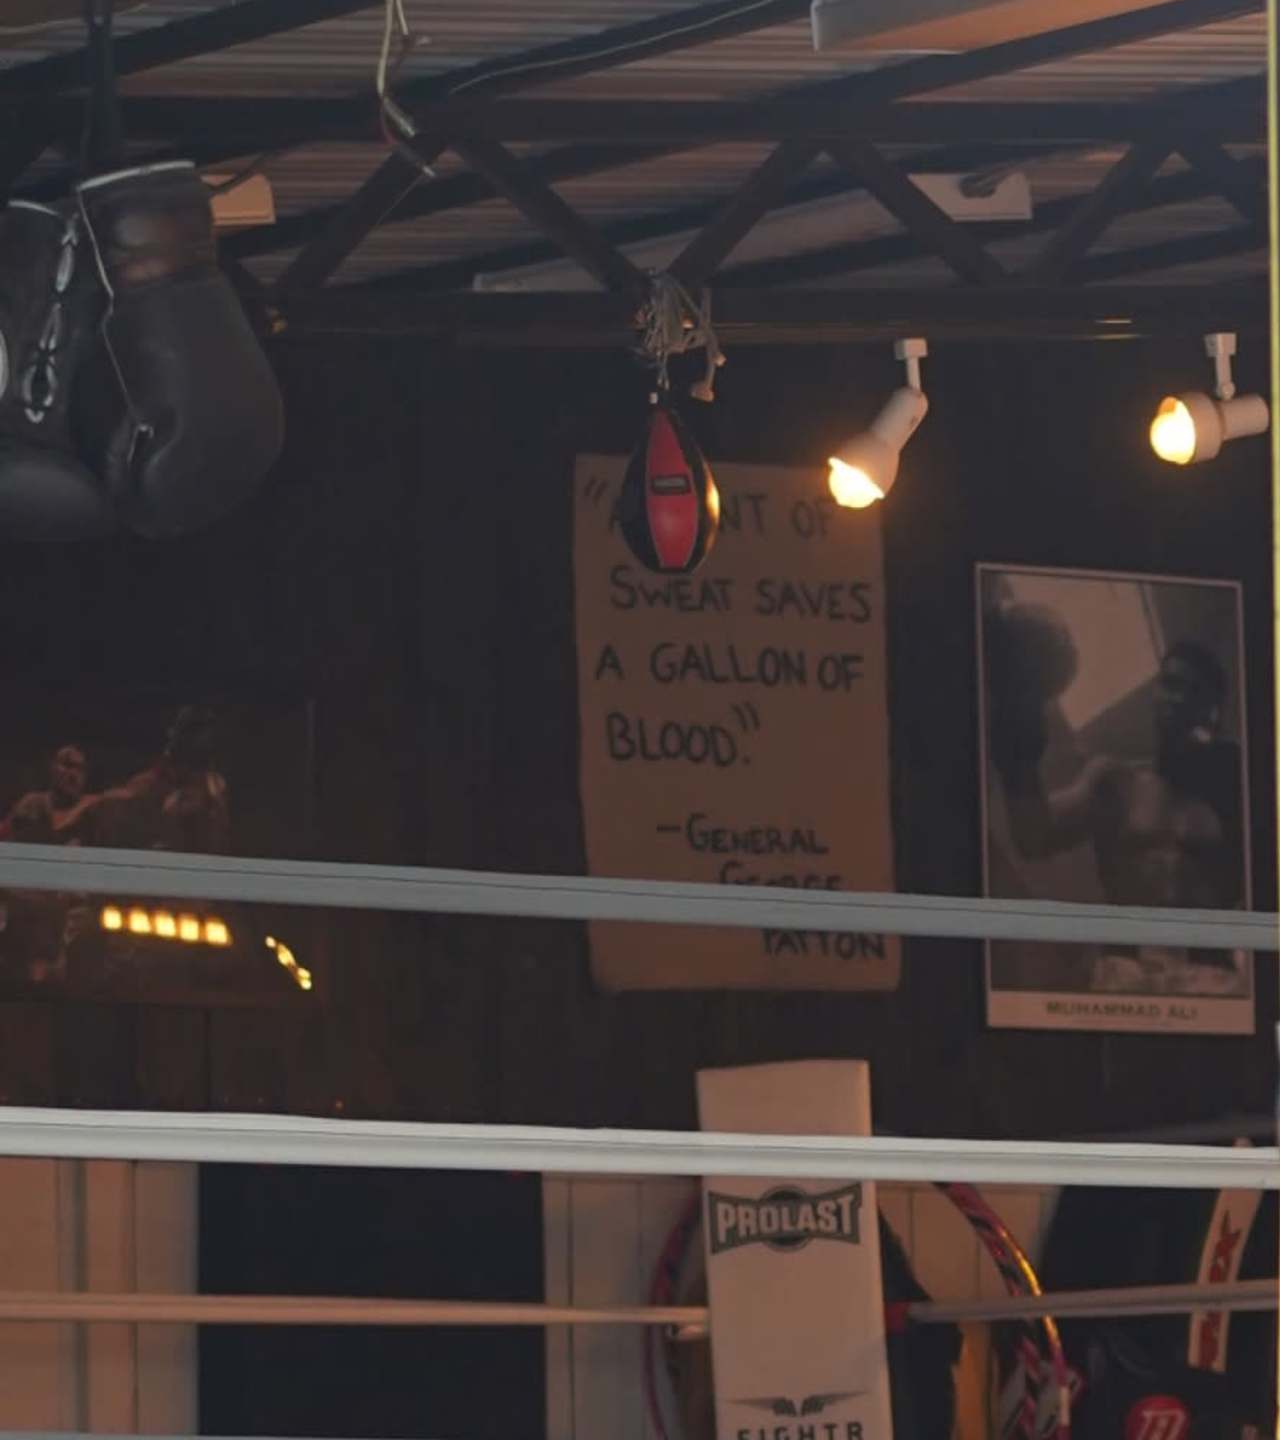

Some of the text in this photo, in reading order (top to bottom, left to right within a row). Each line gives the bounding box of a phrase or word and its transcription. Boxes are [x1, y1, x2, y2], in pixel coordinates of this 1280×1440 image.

[609, 564, 873, 623] SWEAT SAVES
[594, 642, 864, 693] A GALLON OF
[715, 1192, 861, 1245] PROLAST
